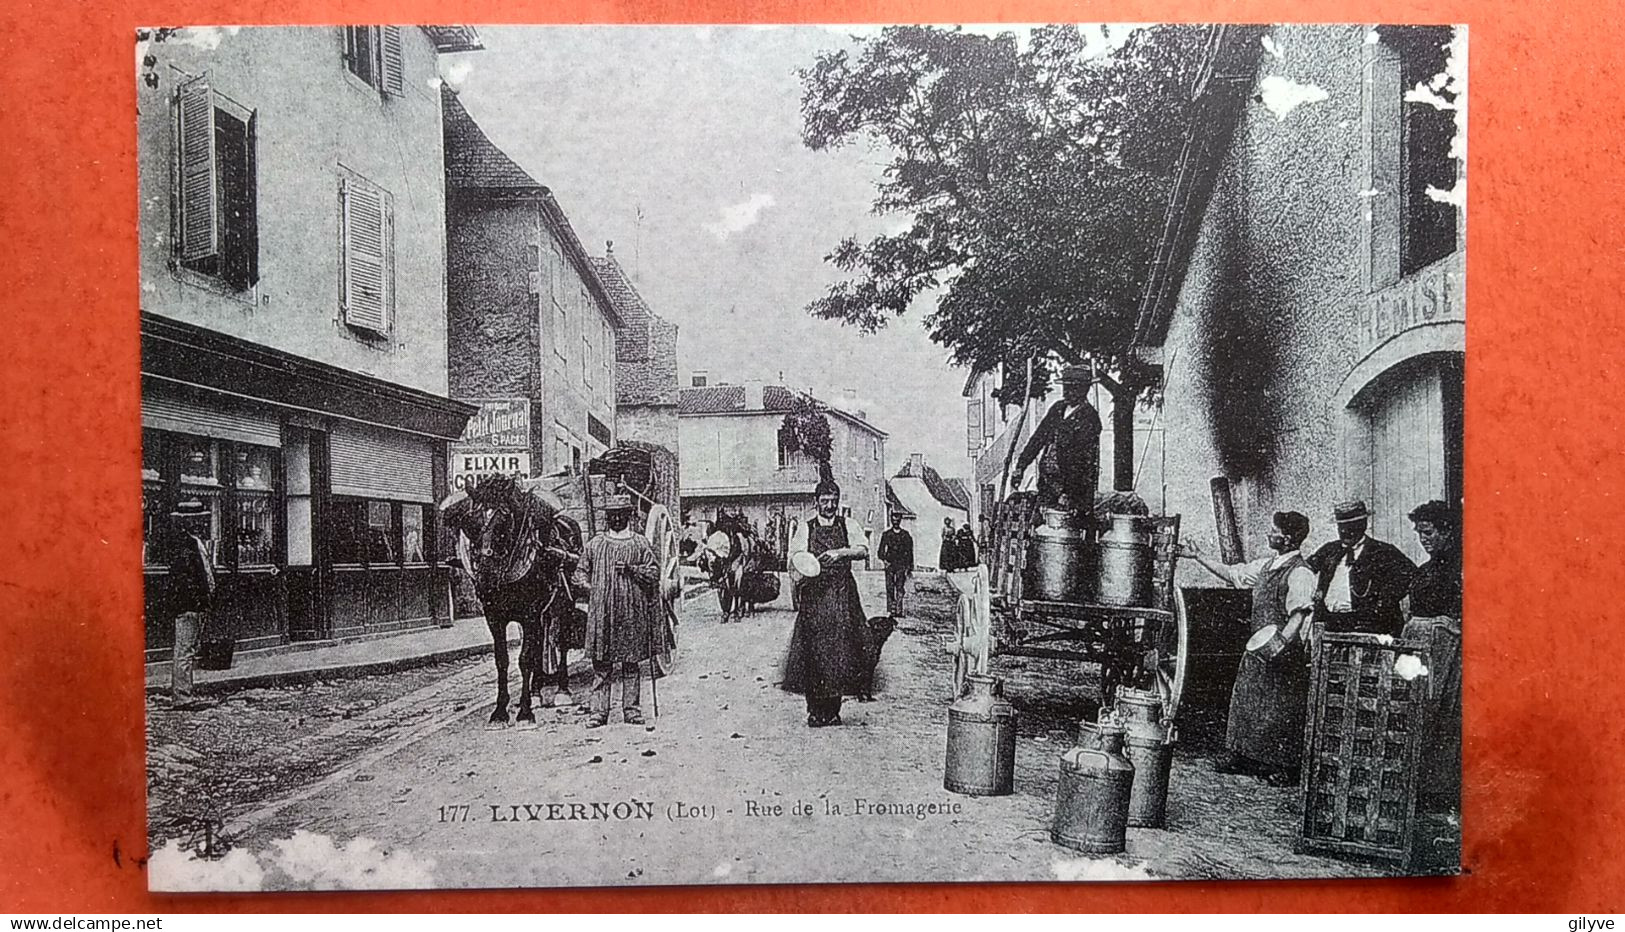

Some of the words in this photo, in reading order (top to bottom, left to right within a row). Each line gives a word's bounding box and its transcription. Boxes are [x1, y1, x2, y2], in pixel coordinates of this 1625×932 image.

[464, 456, 520, 471] ELIXIR
[437, 805, 476, 823] 177.
[489, 802, 654, 822] LIVERNON
[666, 801, 715, 822] (Lot)
[745, 799, 783, 817] Rue
[792, 799, 814, 817] de
[825, 799, 841, 816] la
[854, 798, 962, 820] Fromagerie
